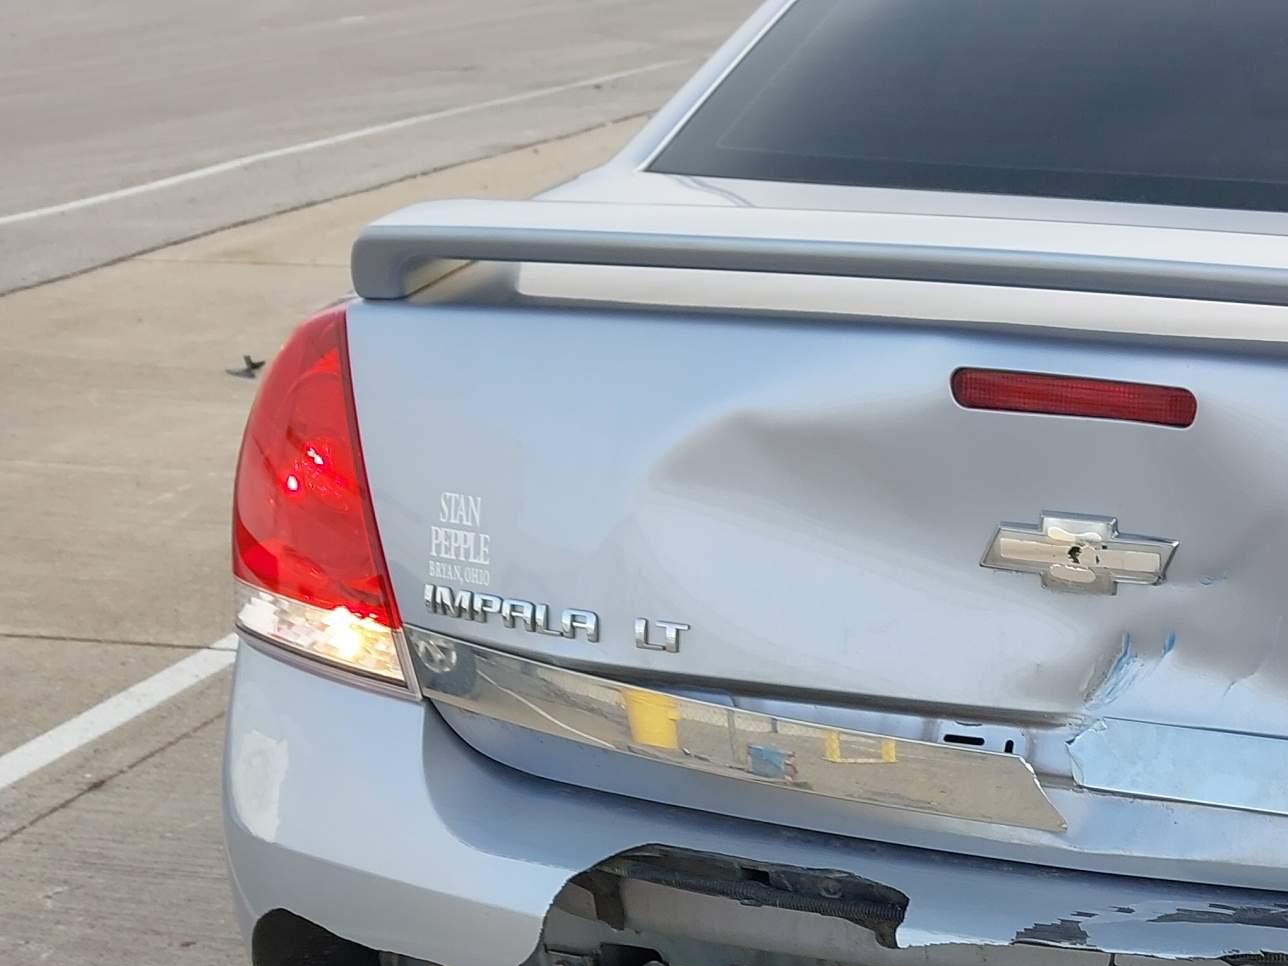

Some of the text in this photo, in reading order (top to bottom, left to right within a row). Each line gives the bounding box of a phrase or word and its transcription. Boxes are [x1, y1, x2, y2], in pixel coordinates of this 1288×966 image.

[440, 492, 481, 528] STAN
[430, 526, 490, 564] PEPPLE
[464, 567, 490, 586] OHIO
[424, 584, 690, 653] IMPALA LT
